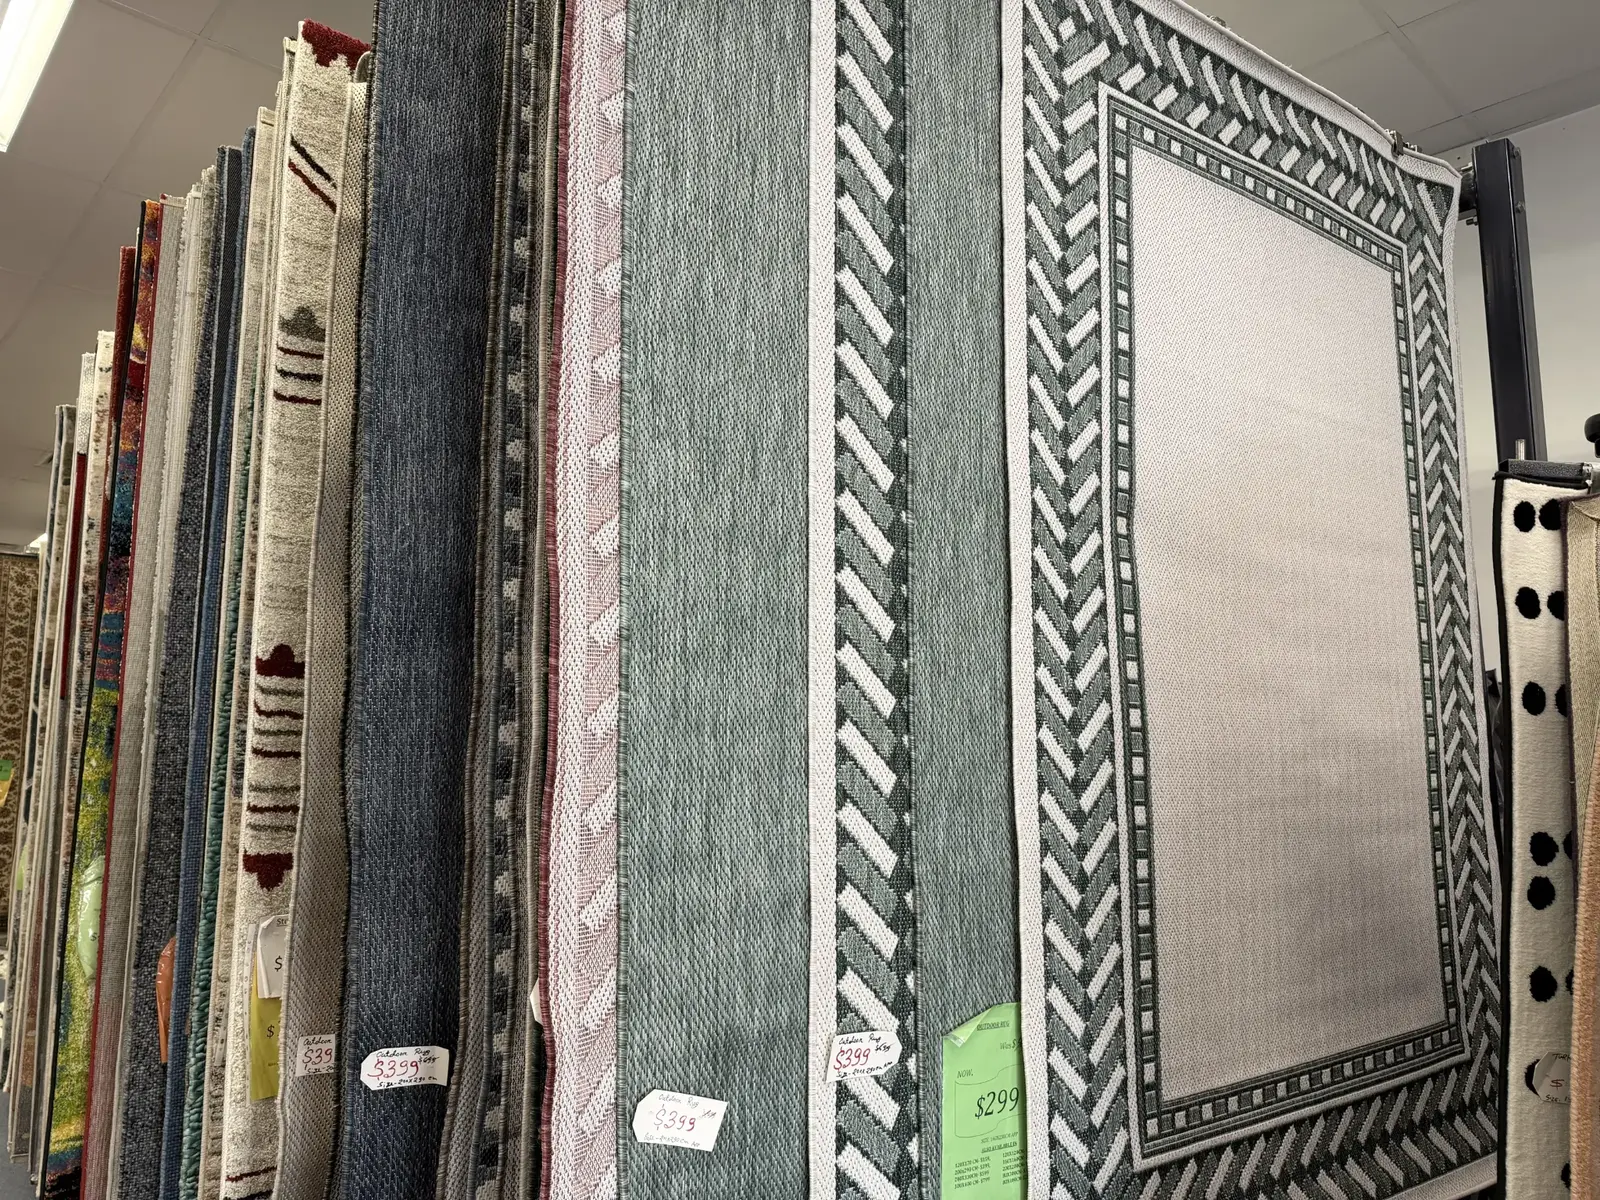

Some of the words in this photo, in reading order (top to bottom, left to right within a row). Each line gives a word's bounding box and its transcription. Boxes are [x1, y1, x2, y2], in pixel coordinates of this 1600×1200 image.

[274, 955, 283, 972] $
[266, 1024, 275, 1039] $
[302, 1046, 333, 1070] $39
[367, 1058, 419, 1081] $399
[833, 1046, 871, 1073] $399
[1550, 1079, 1565, 1090] $
[975, 1087, 1020, 1119] $299
[653, 1103, 696, 1132] $399
